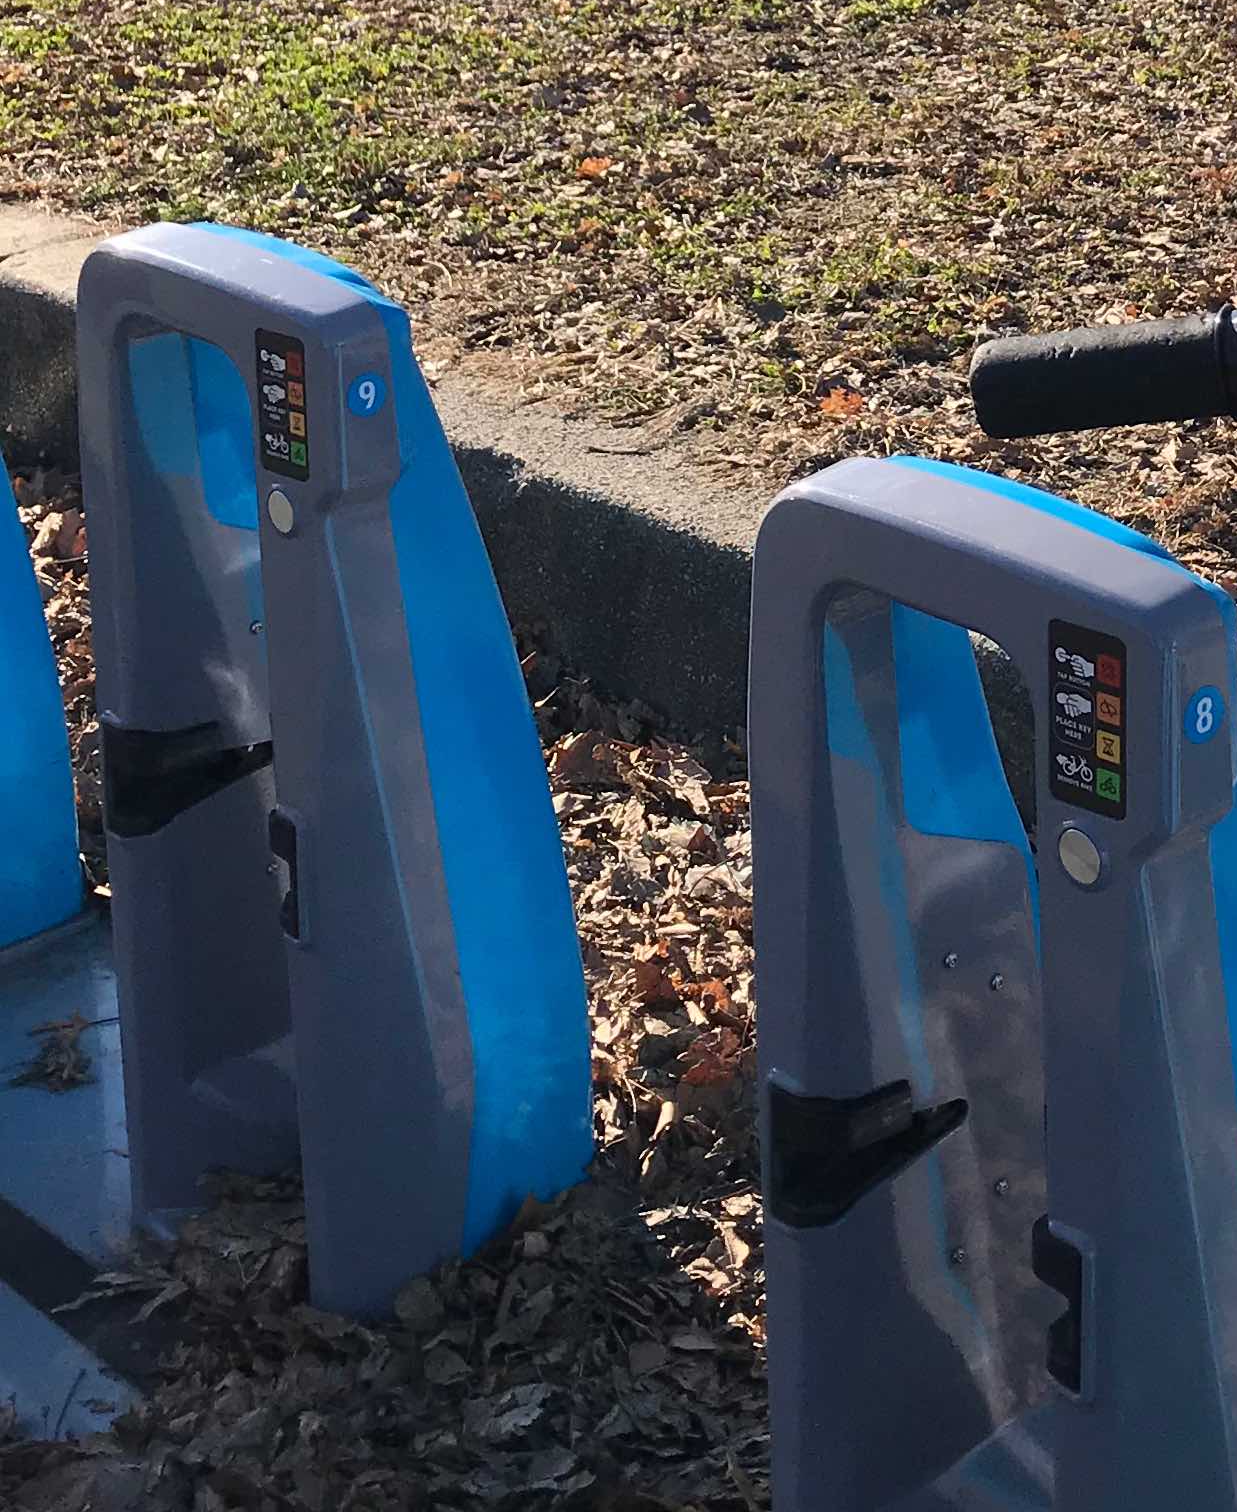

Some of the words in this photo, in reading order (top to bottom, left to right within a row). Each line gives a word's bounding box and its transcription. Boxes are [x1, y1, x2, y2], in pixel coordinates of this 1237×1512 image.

[358, 380, 376, 409] 9
[1056, 715, 1077, 729] PLACE
[1078, 722, 1092, 734] KEY
[1195, 697, 1213, 734] 8
